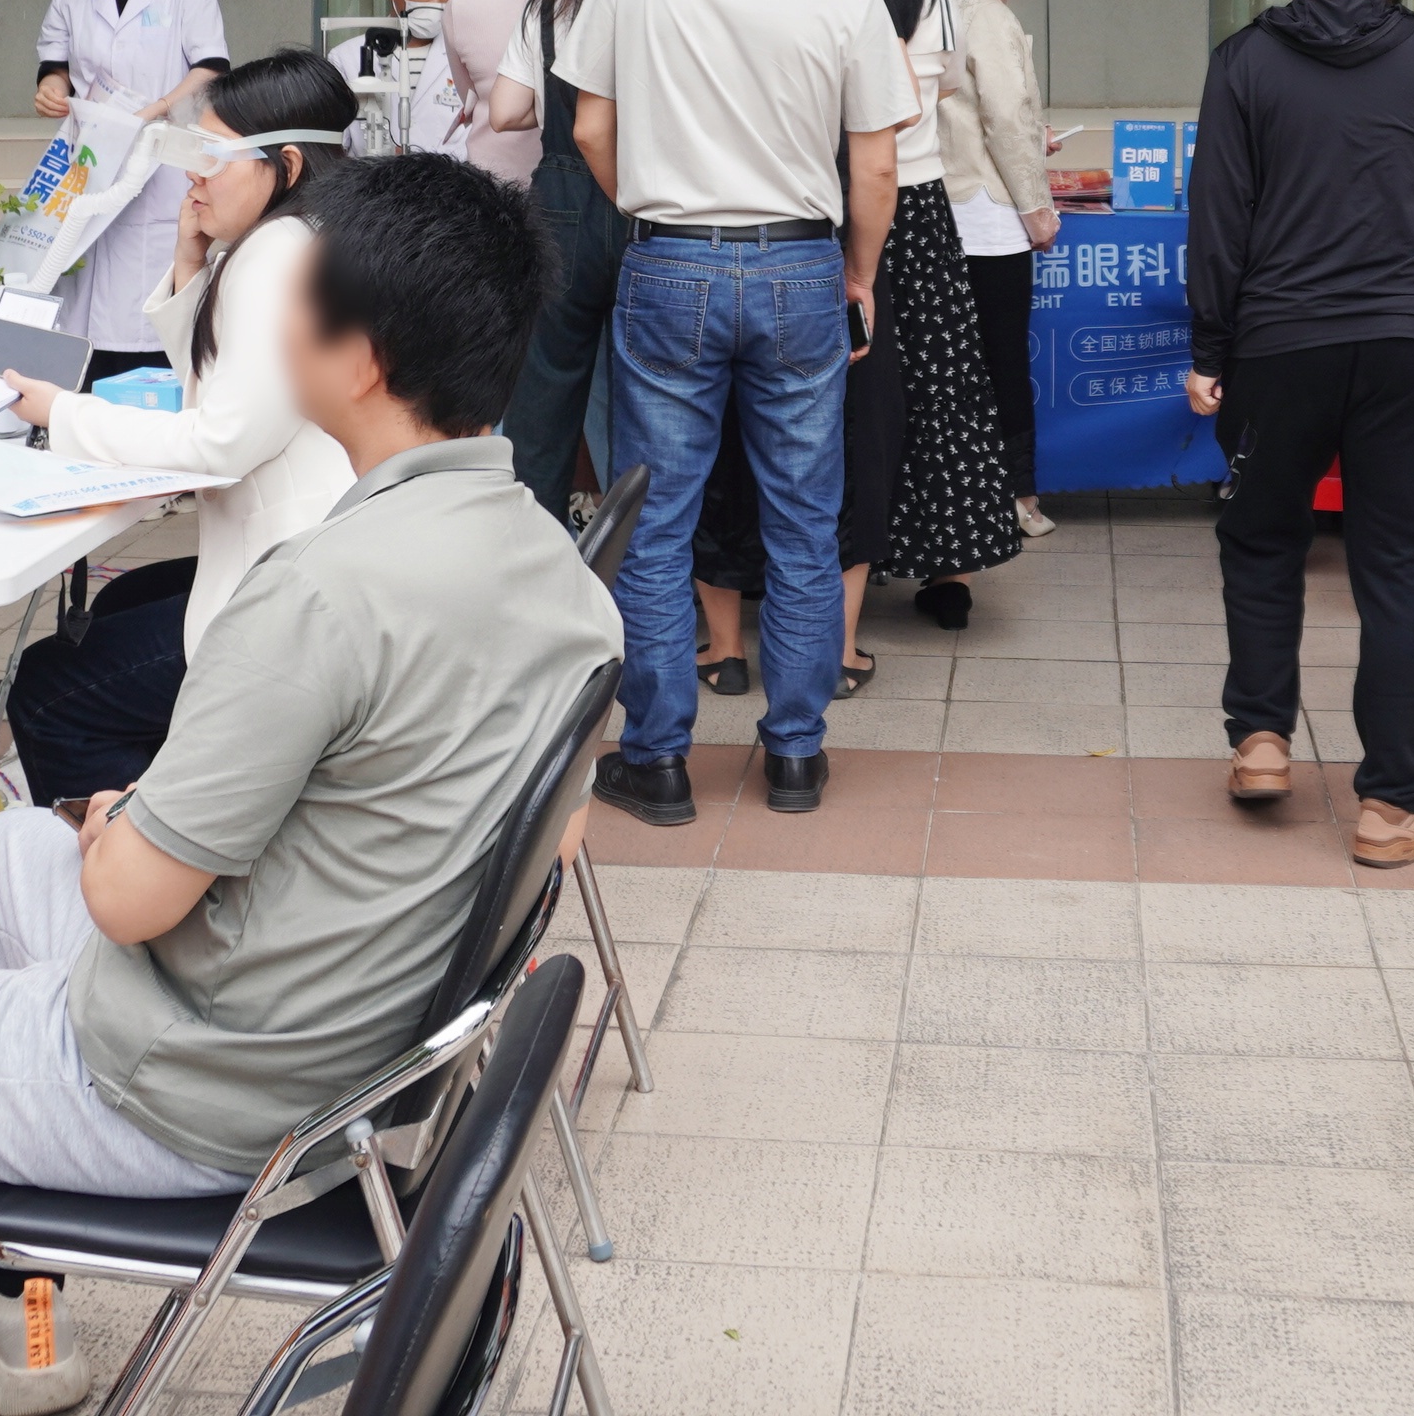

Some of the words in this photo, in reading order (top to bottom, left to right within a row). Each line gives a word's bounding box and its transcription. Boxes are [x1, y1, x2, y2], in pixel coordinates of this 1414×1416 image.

[1122, 148, 1168, 163] 白内障
[1130, 166, 1160, 182] 咨询
[1107, 292, 1142, 307] EYE
[1081, 326, 1192, 354] 全国连锁眼科
